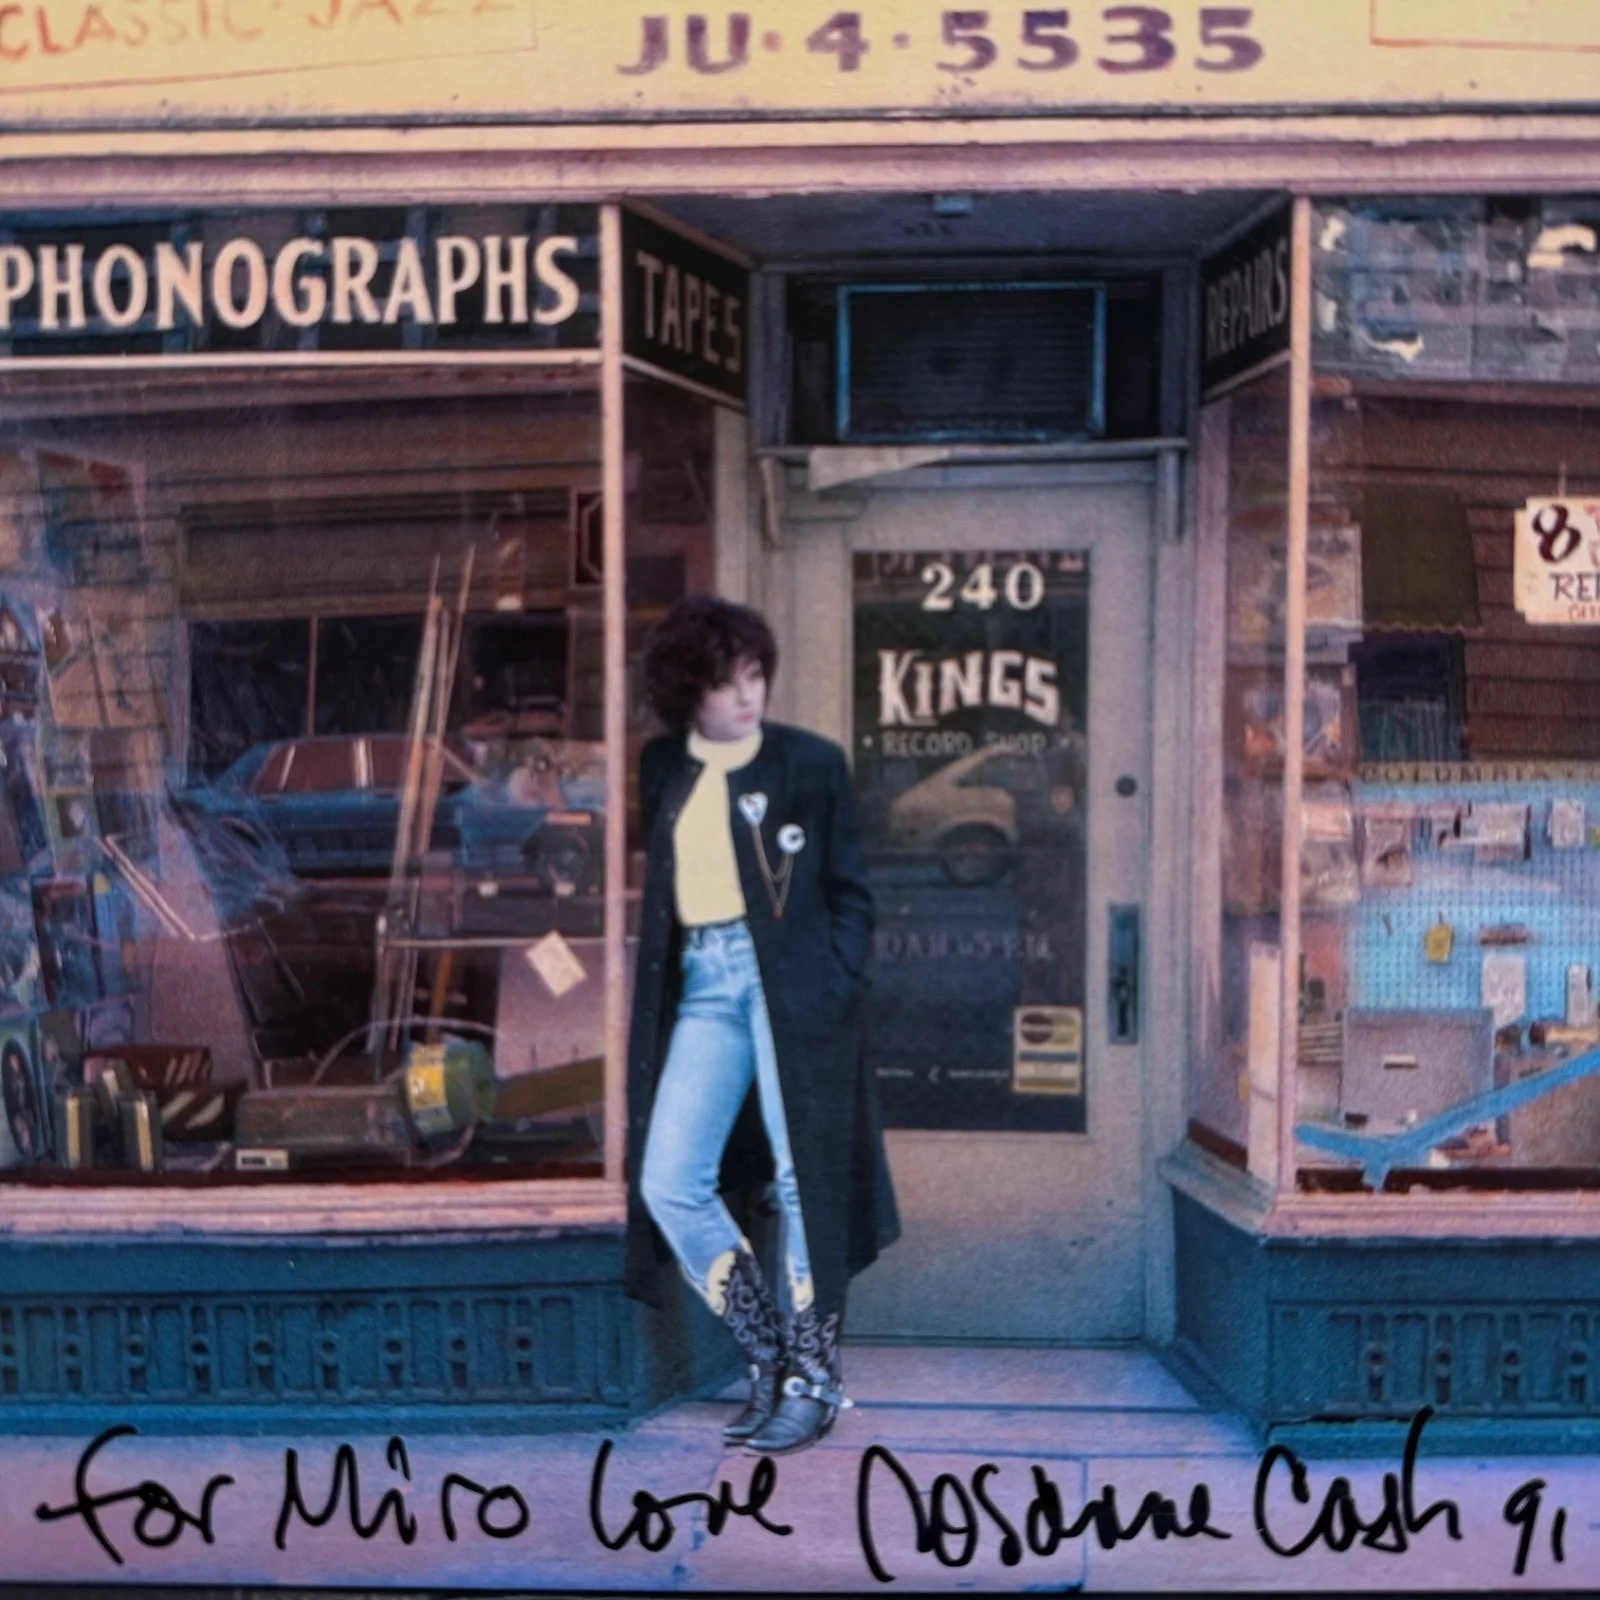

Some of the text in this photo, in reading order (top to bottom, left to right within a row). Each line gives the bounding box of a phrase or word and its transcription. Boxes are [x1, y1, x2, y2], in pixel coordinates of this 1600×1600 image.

[0, 0, 263, 60] CLASSIC
[0, 234, 580, 330] PHONOGRAPHS
[636, 249, 742, 374] TAPES
[1205, 236, 1288, 361] REPAIRS
[1532, 504, 1581, 564] 8
[921, 563, 1045, 611] 240
[877, 649, 1060, 727] KINGS
[880, 731, 974, 758] RECORD
[275, 1435, 530, 1551] Miro
[1254, 1406, 1463, 1558] Cash
